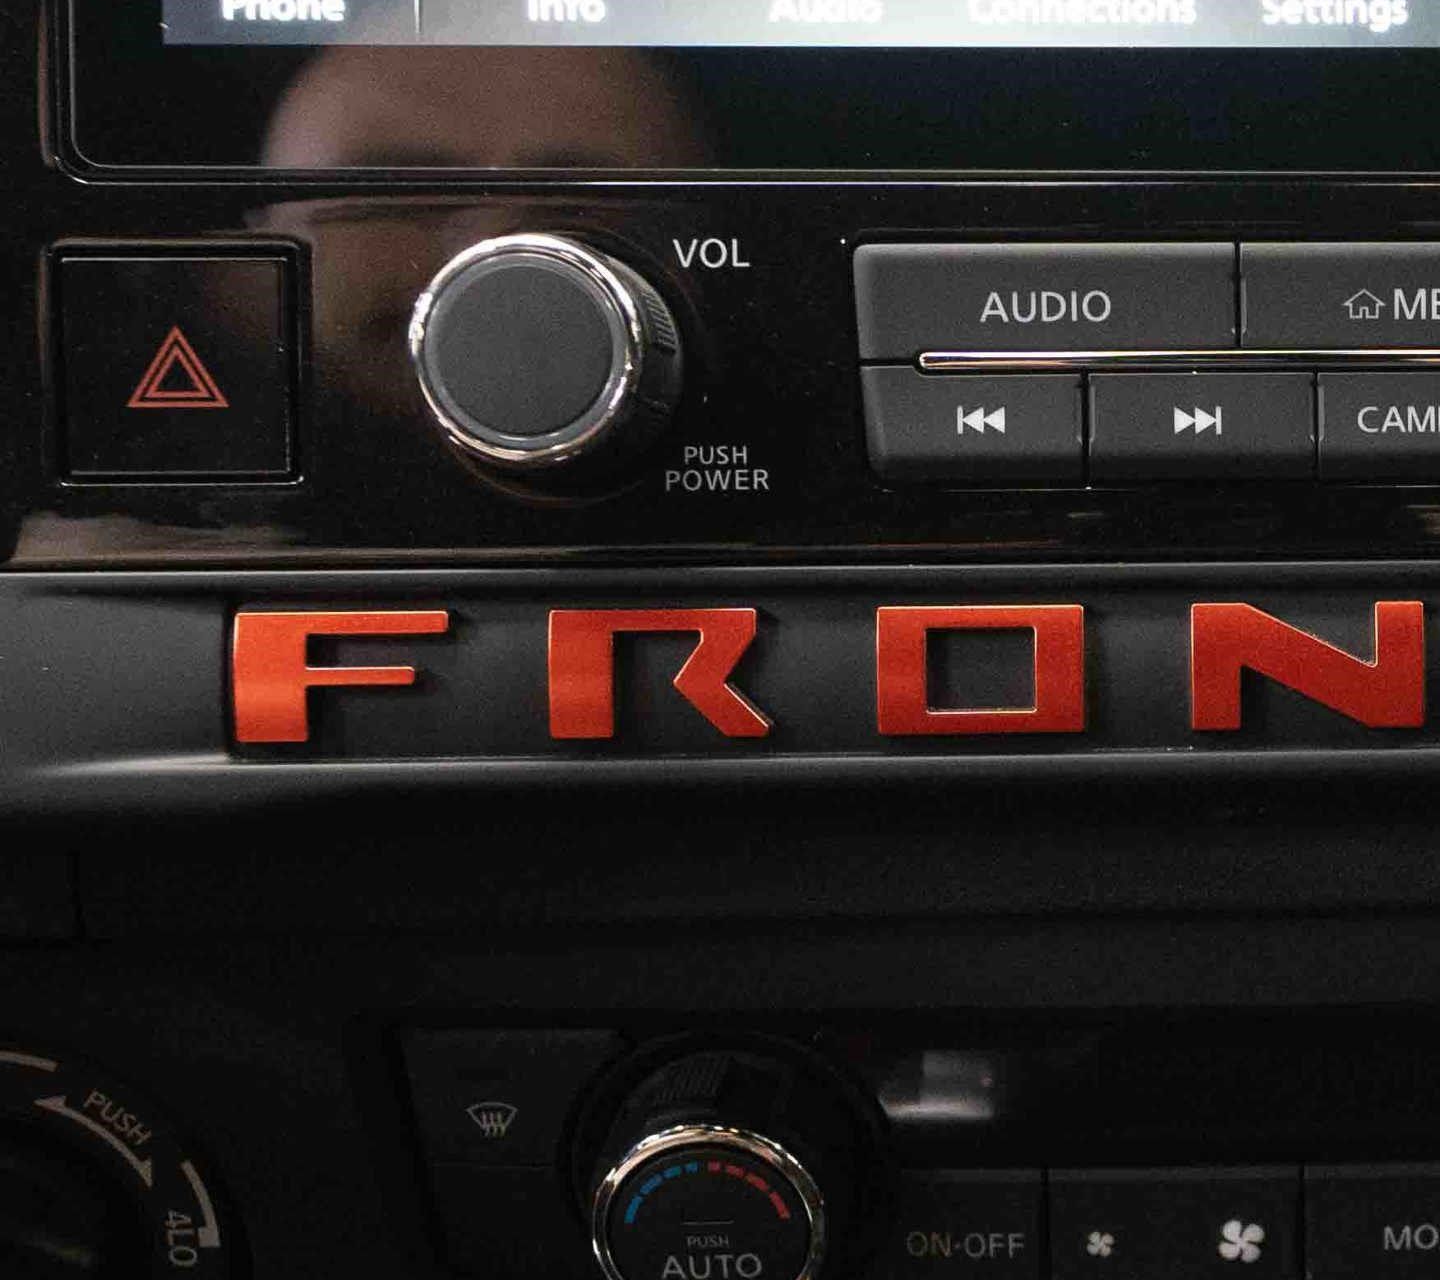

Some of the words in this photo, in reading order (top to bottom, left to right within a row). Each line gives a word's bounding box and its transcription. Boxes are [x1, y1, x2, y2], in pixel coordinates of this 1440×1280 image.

[673, 238, 750, 269] VOL
[980, 290, 1112, 324] AUDIO
[683, 444, 749, 466] PUSH
[665, 468, 770, 492] POWER
[84, 1088, 153, 1147] PUSH
[686, 1234, 730, 1249] PUSH
[905, 1230, 1026, 1260] ON-OFF
